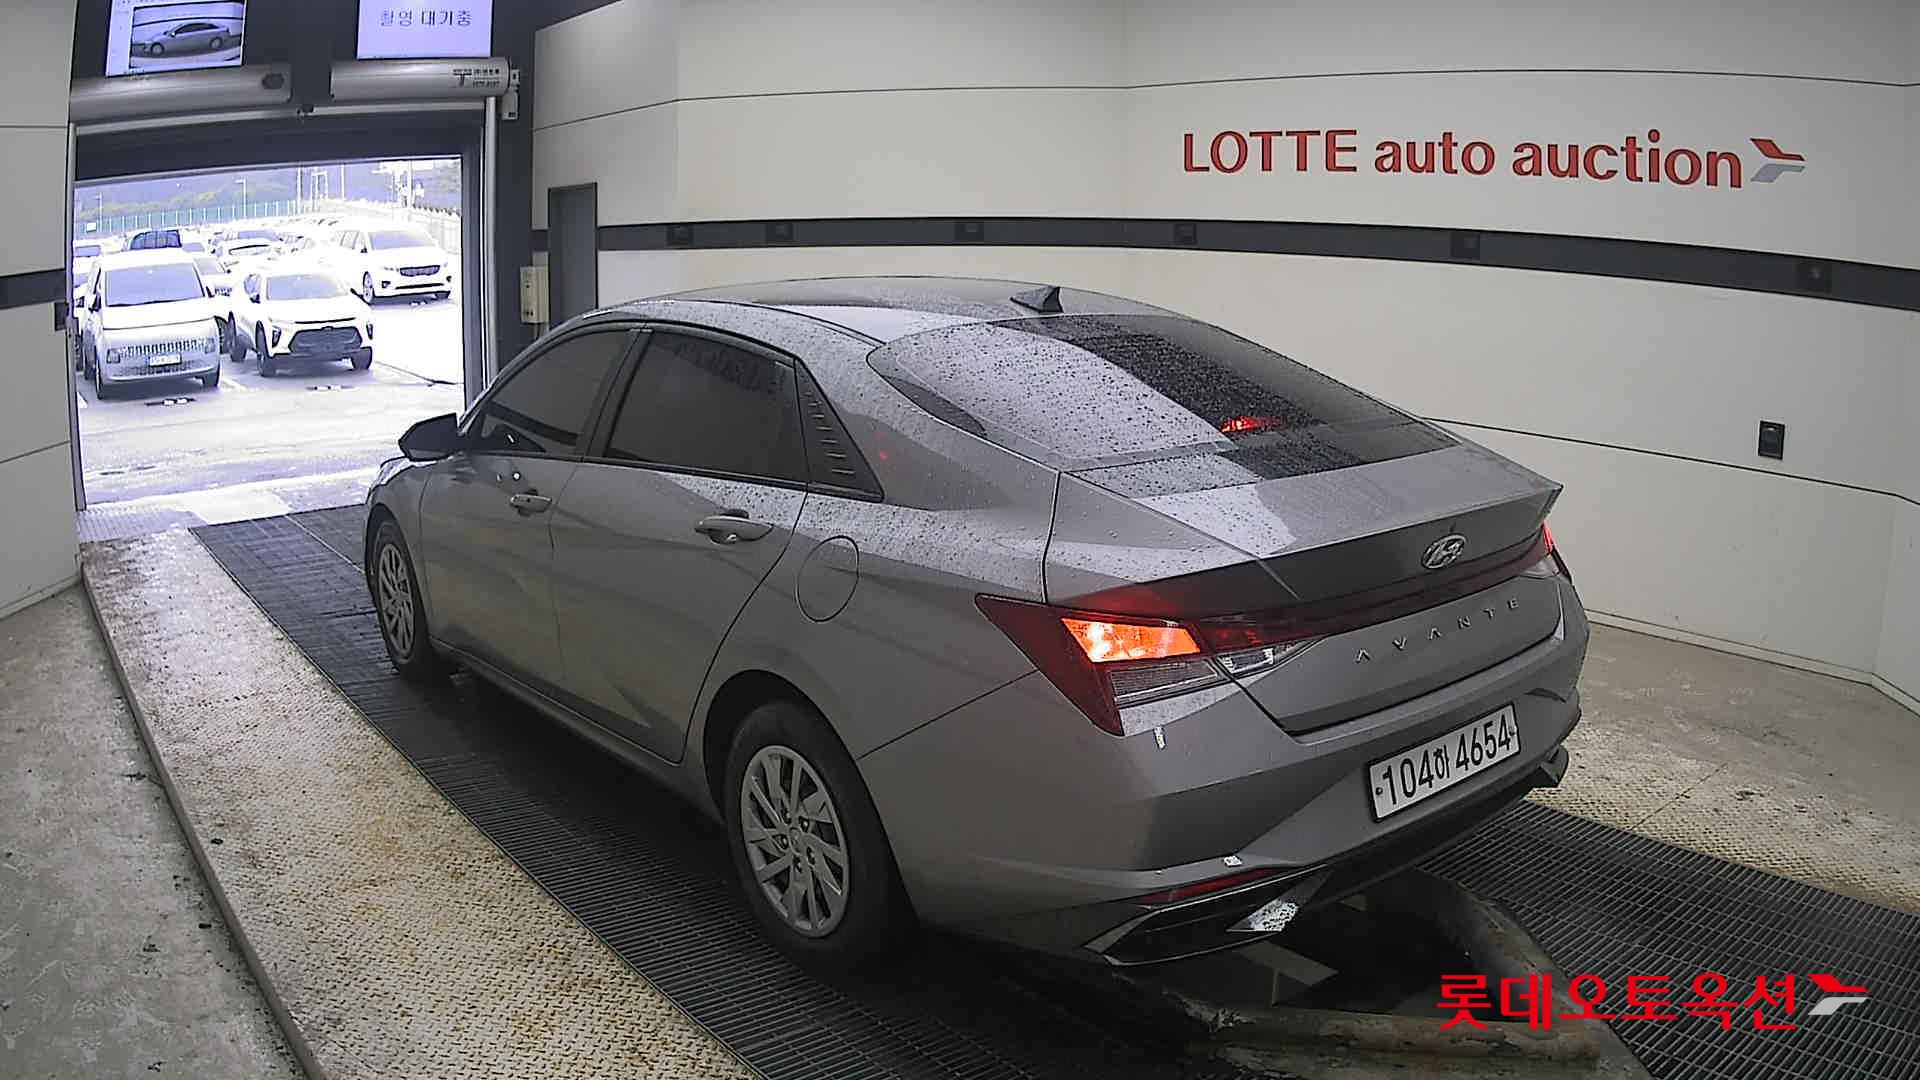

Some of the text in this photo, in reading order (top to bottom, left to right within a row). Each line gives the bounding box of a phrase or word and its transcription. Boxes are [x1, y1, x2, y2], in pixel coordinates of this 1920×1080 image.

[421, 10, 472, 26] 대기중
[1184, 129, 1743, 188] LOTTE auto auction
[1356, 598, 1519, 664] AVANTE
